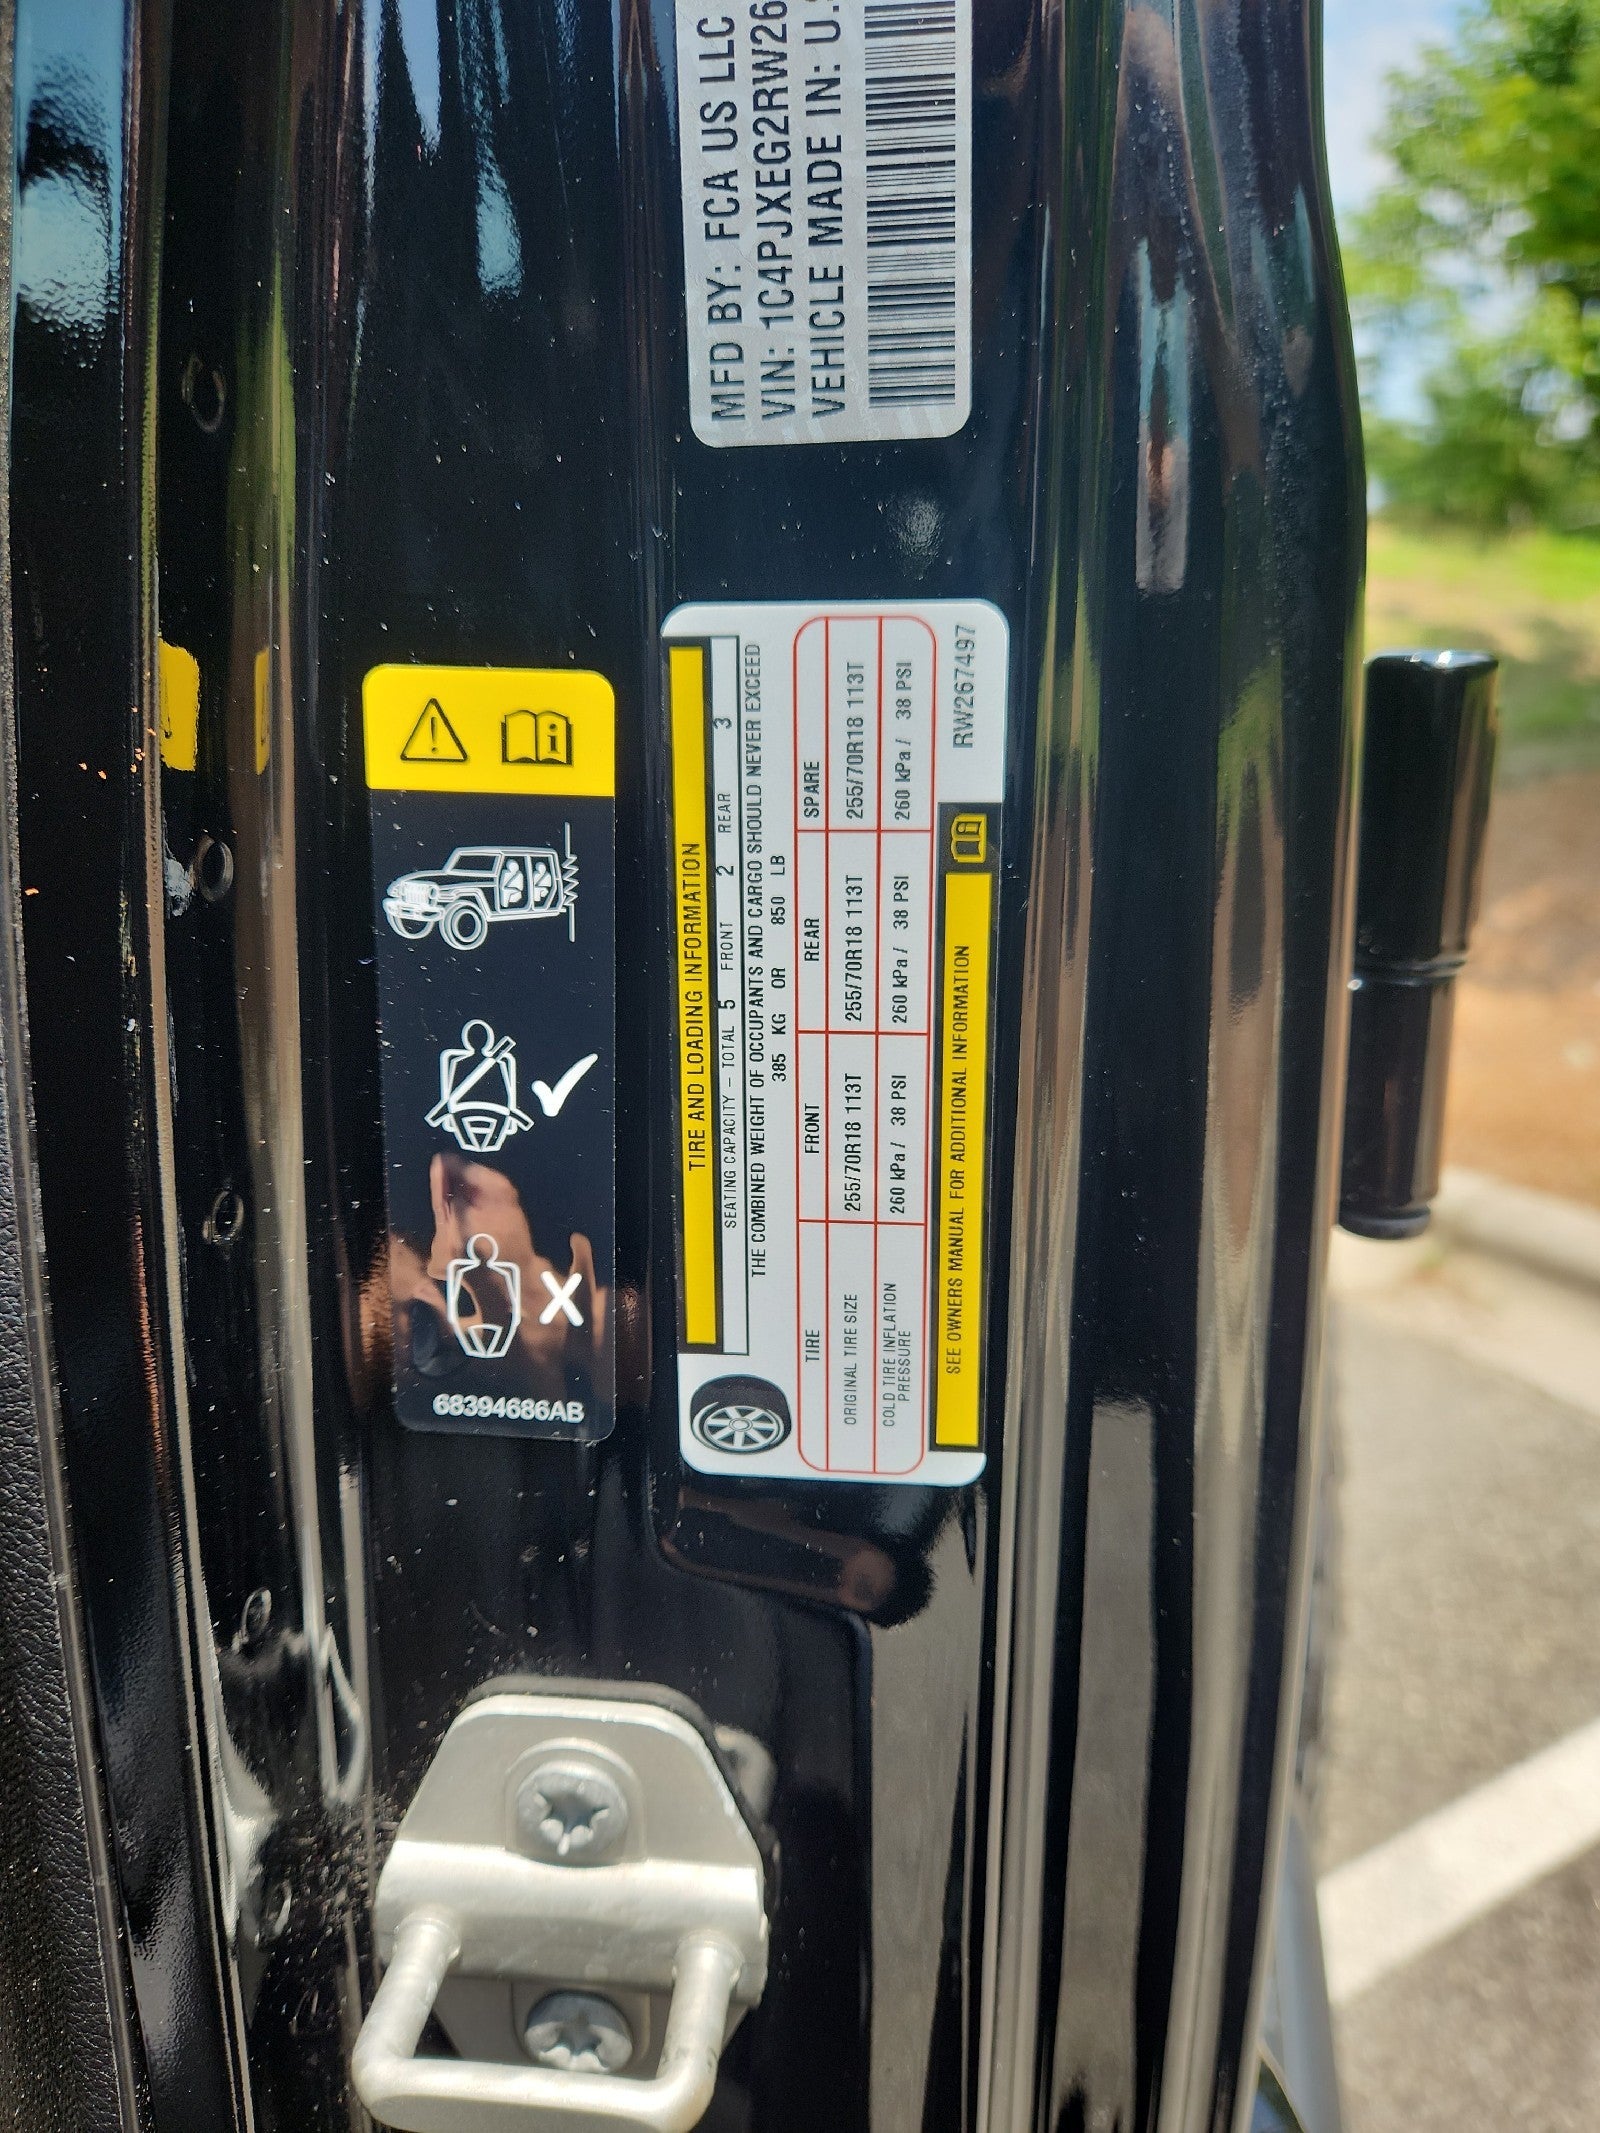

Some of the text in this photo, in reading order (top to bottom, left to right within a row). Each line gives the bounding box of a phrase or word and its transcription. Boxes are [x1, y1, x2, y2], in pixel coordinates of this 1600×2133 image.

[696, 16, 746, 422] MFD BY: FCA US LLC
[803, 0, 846, 419] VEHICLE MADE IN: U.
[759, 347, 796, 422] VIN:
[896, 662, 912, 692] PSI
[952, 624, 977, 749] RW267497
[713, 717, 732, 729] 3
[895, 698, 912, 720] 38
[846, 662, 865, 820] 255/70R18 113T
[895, 751, 911, 783] kPa
[804, 761, 820, 819] SPARE
[894, 789, 911, 821] 260
[717, 792, 732, 834] REAR
[715, 865, 734, 876] 2
[893, 875, 910, 903] PSI
[804, 917, 820, 962] REAR
[893, 909, 909, 930] 38
[719, 921, 734, 971] FRONT
[744, 644, 766, 1278] THE COMBINED WEIGHT OF OCCUPANTS AND CARGO SHOULD NEVER EXCEED
[771, 855, 787, 1082] 385 KG OR 850 LB
[845, 874, 863, 1022] 255/70R18 113T
[892, 958, 908, 988] kPa
[681, 842, 706, 1171] TIRE AND LOADING INFORMATION
[718, 999, 736, 1010] 5
[892, 994, 908, 1024] 260
[721, 1025, 736, 1068] TOTAL
[891, 1075, 907, 1100] PSI
[722, 1095, 737, 1164] CAPACITY
[805, 1103, 820, 1154] FRONT
[891, 1107, 907, 1126] 38
[844, 1073, 862, 1212] 255/70R18 113T
[947, 945, 970, 1375] SEE OWNERS MANUAL FOR ADDITIONAL INFORMATION
[891, 1153, 906, 1181] kPa
[723, 1170, 737, 1229] SEATING
[890, 1187, 906, 1214] 260
[805, 1329, 820, 1363] TIRE
[844, 1293, 858, 1425] ORIGINAL TIRE SIZE
[883, 1283, 897, 1427] COLD TIRE INFLATION
[898, 1330, 911, 1402] PRESSURE
[432, 1393, 585, 1424] 68394686AB
